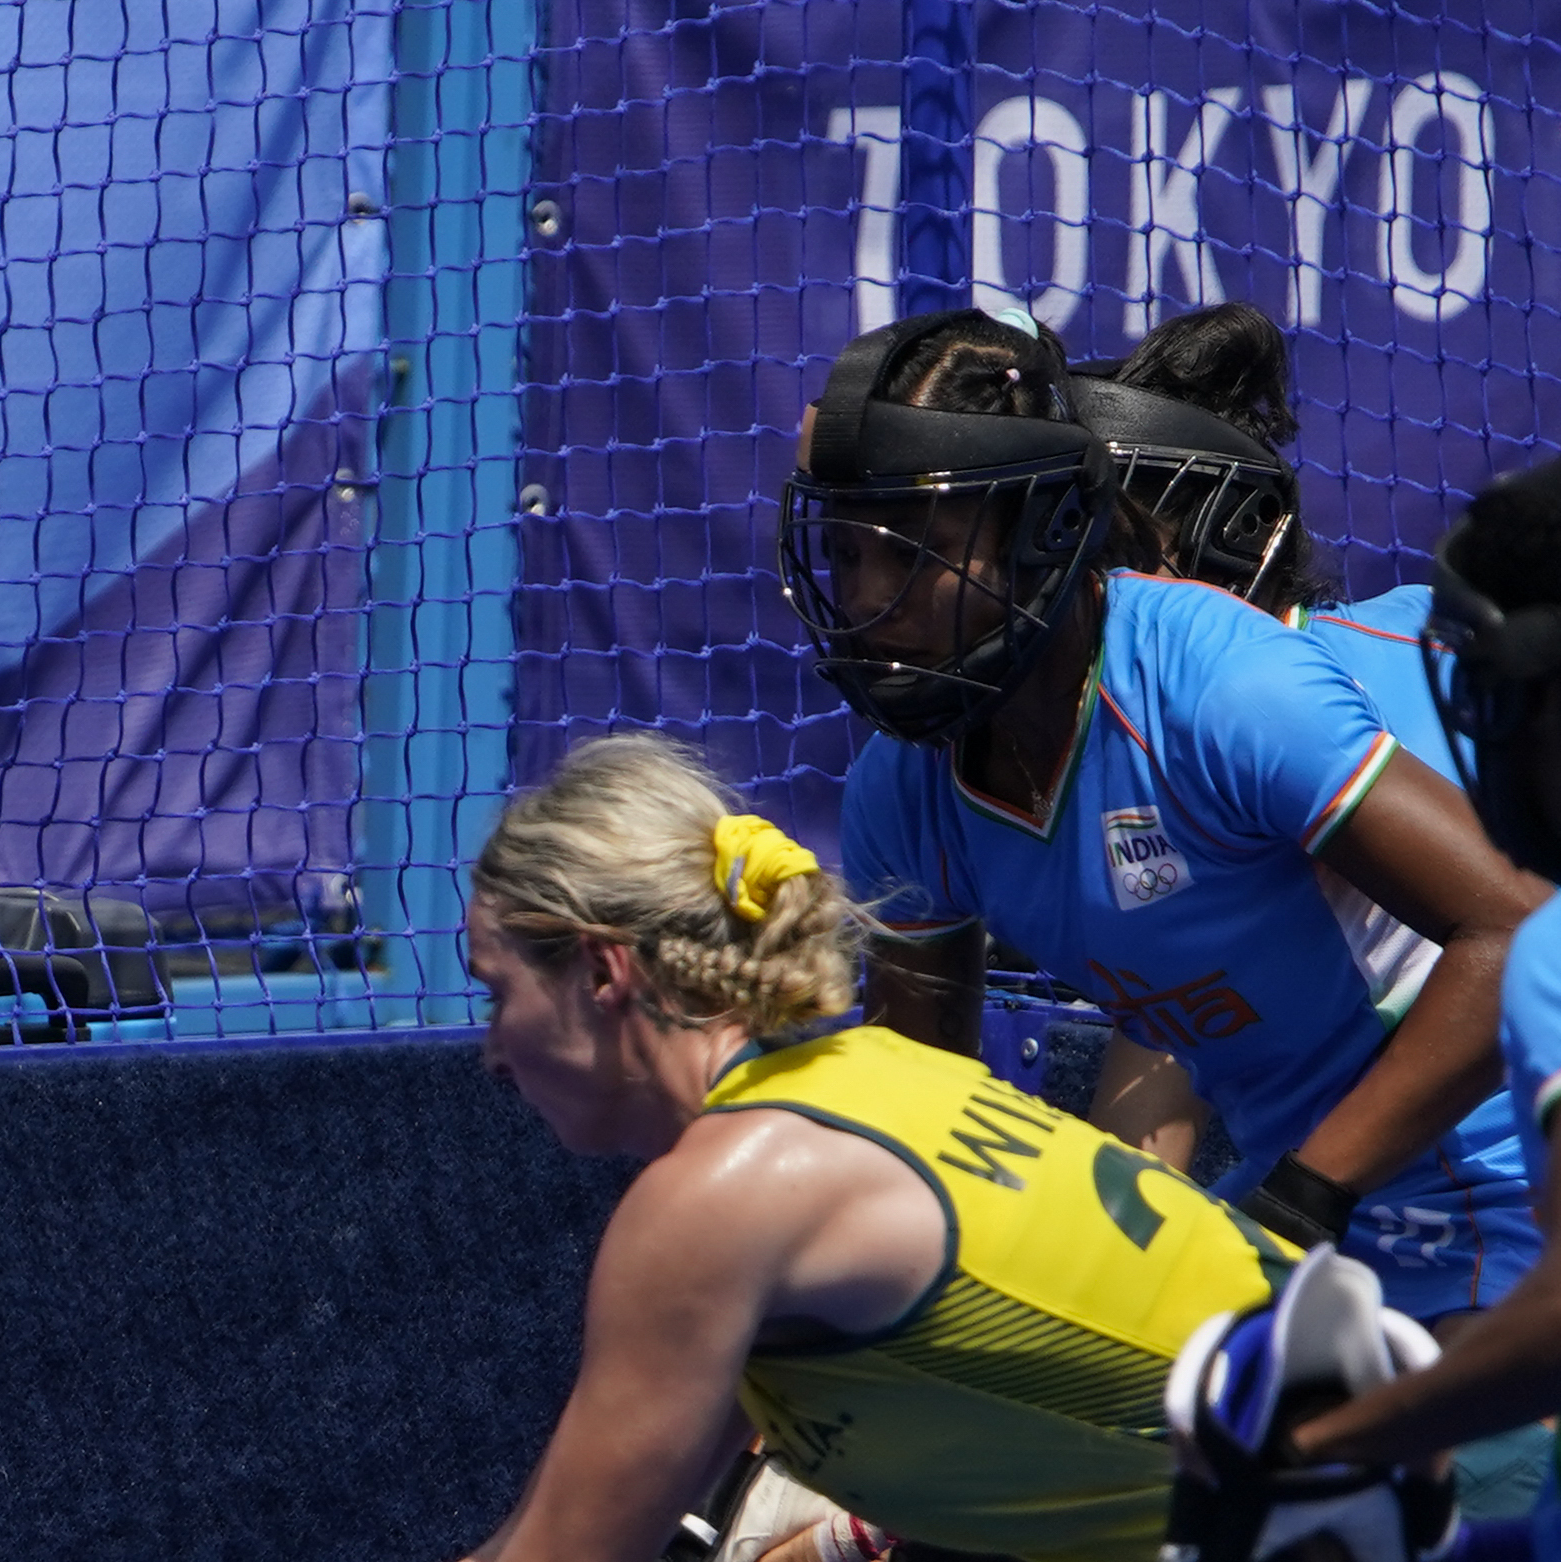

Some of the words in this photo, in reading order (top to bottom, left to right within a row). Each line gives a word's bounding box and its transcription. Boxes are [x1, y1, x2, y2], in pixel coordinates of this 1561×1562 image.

[827, 71, 1497, 341] TOKYO
[1106, 832, 1178, 868] INDIA
[937, 1081, 1063, 1192] WI
